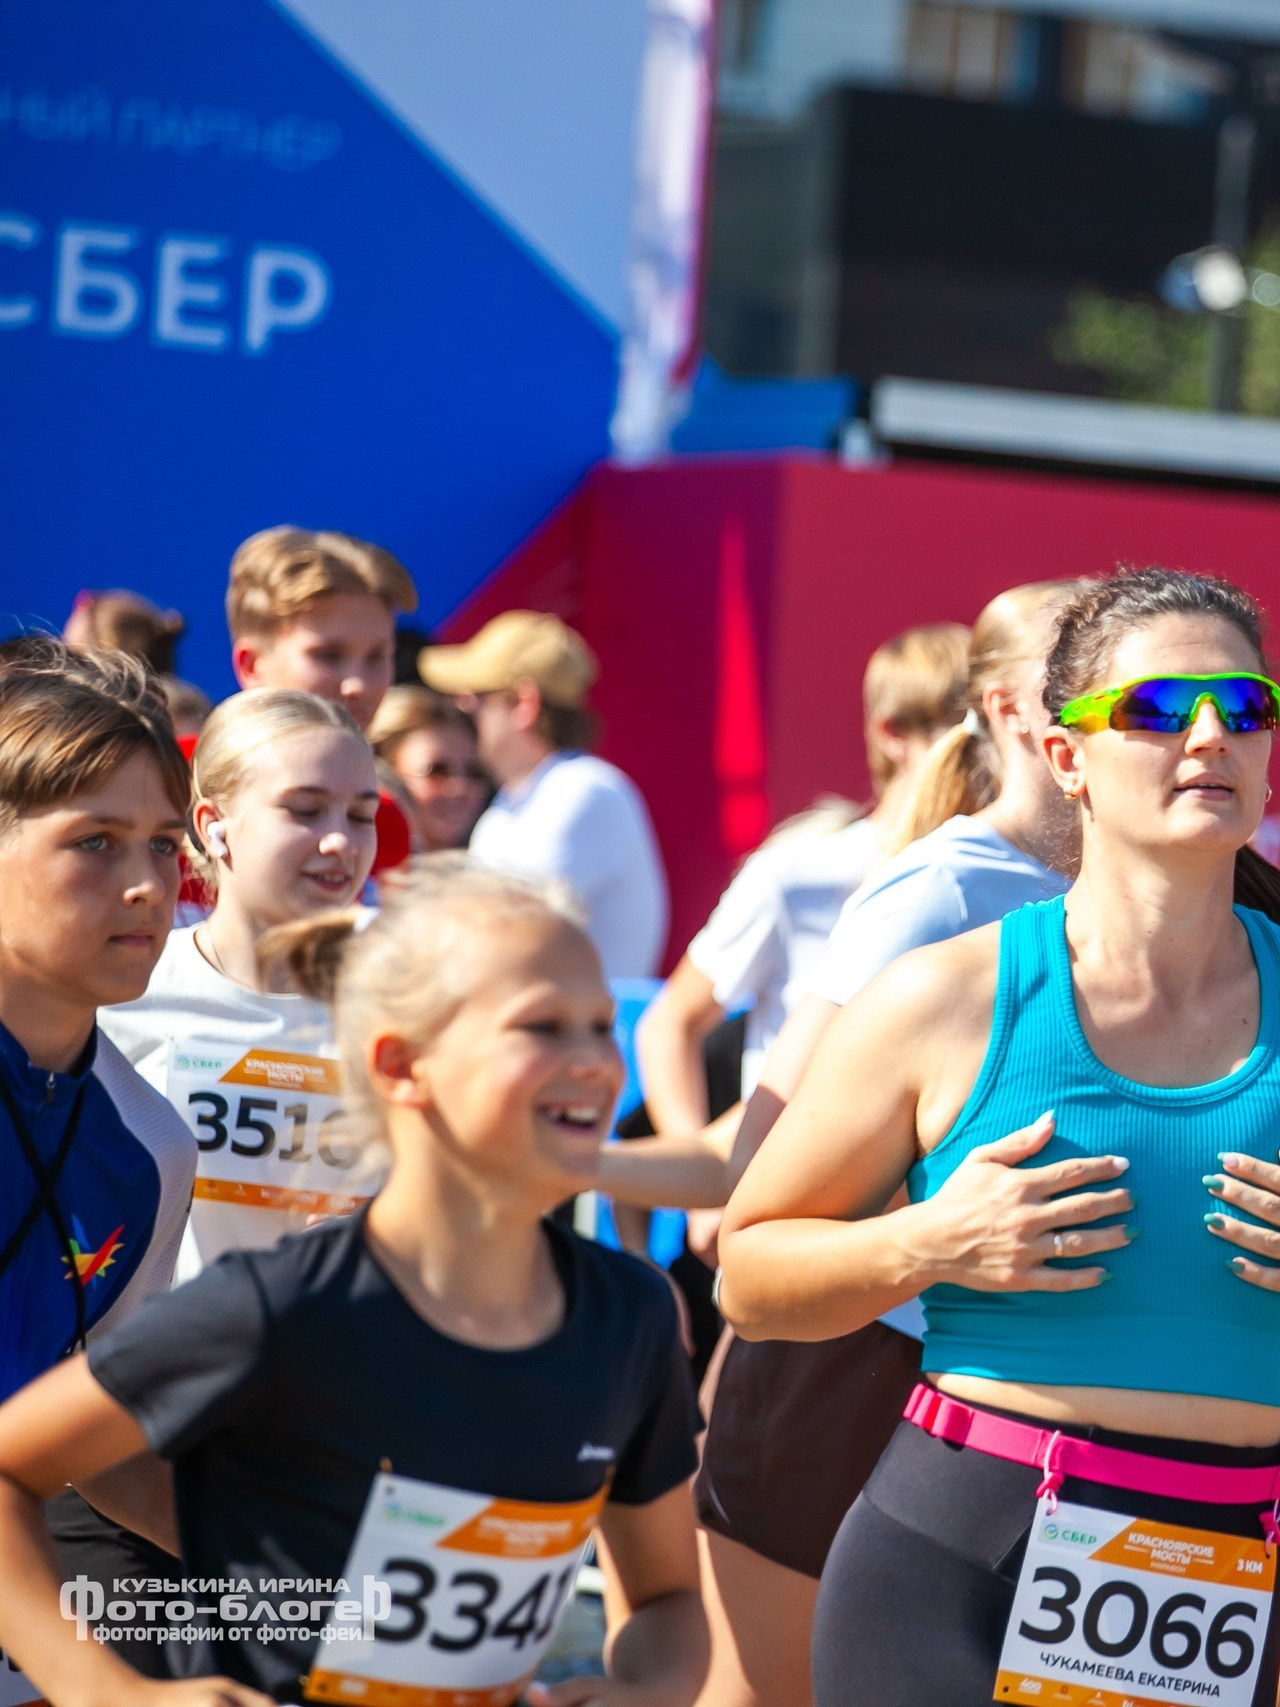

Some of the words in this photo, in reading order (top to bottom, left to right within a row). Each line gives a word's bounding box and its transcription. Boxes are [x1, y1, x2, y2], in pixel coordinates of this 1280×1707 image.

[1062, 1530, 1098, 1545] СБЕР
[1128, 1532, 1215, 1558] КРАСНОЯРСКИЕ
[1151, 1548, 1192, 1565] МОСТЫ
[1236, 1558, 1244, 1572] 3
[1245, 1559, 1264, 1575] КМ
[1018, 1566, 1259, 1679] 3066
[1040, 1652, 1134, 1683] ЧУКАМЕЕВА
[1137, 1672, 1221, 1698] ЕКАТЕРИНА
